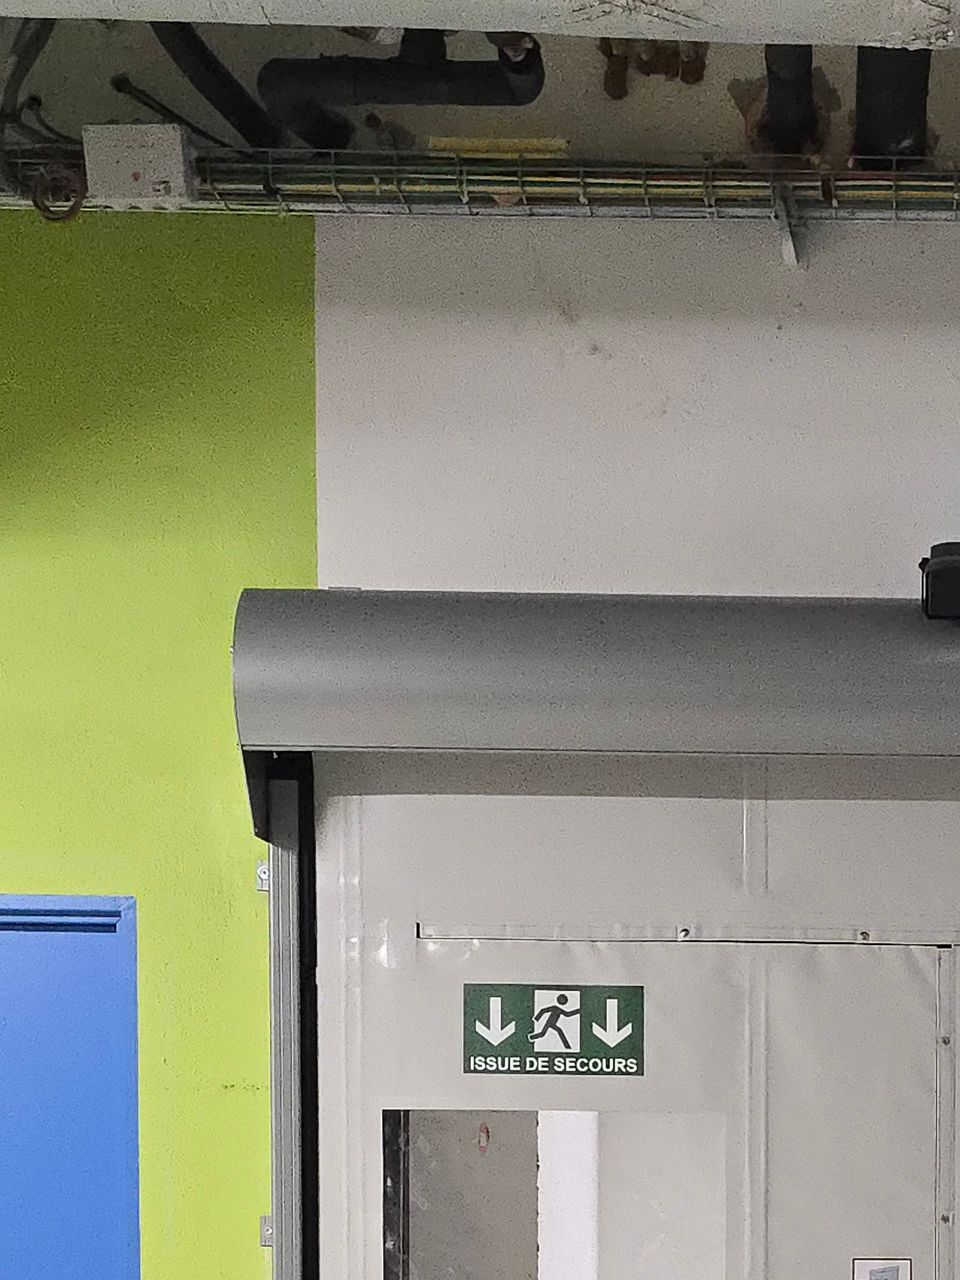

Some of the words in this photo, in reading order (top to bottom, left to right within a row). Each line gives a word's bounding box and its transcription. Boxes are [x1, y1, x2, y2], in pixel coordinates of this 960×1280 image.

[470, 1056, 521, 1071] ISSUE
[525, 1057, 549, 1071] DE
[553, 1057, 638, 1073] SECOURS
